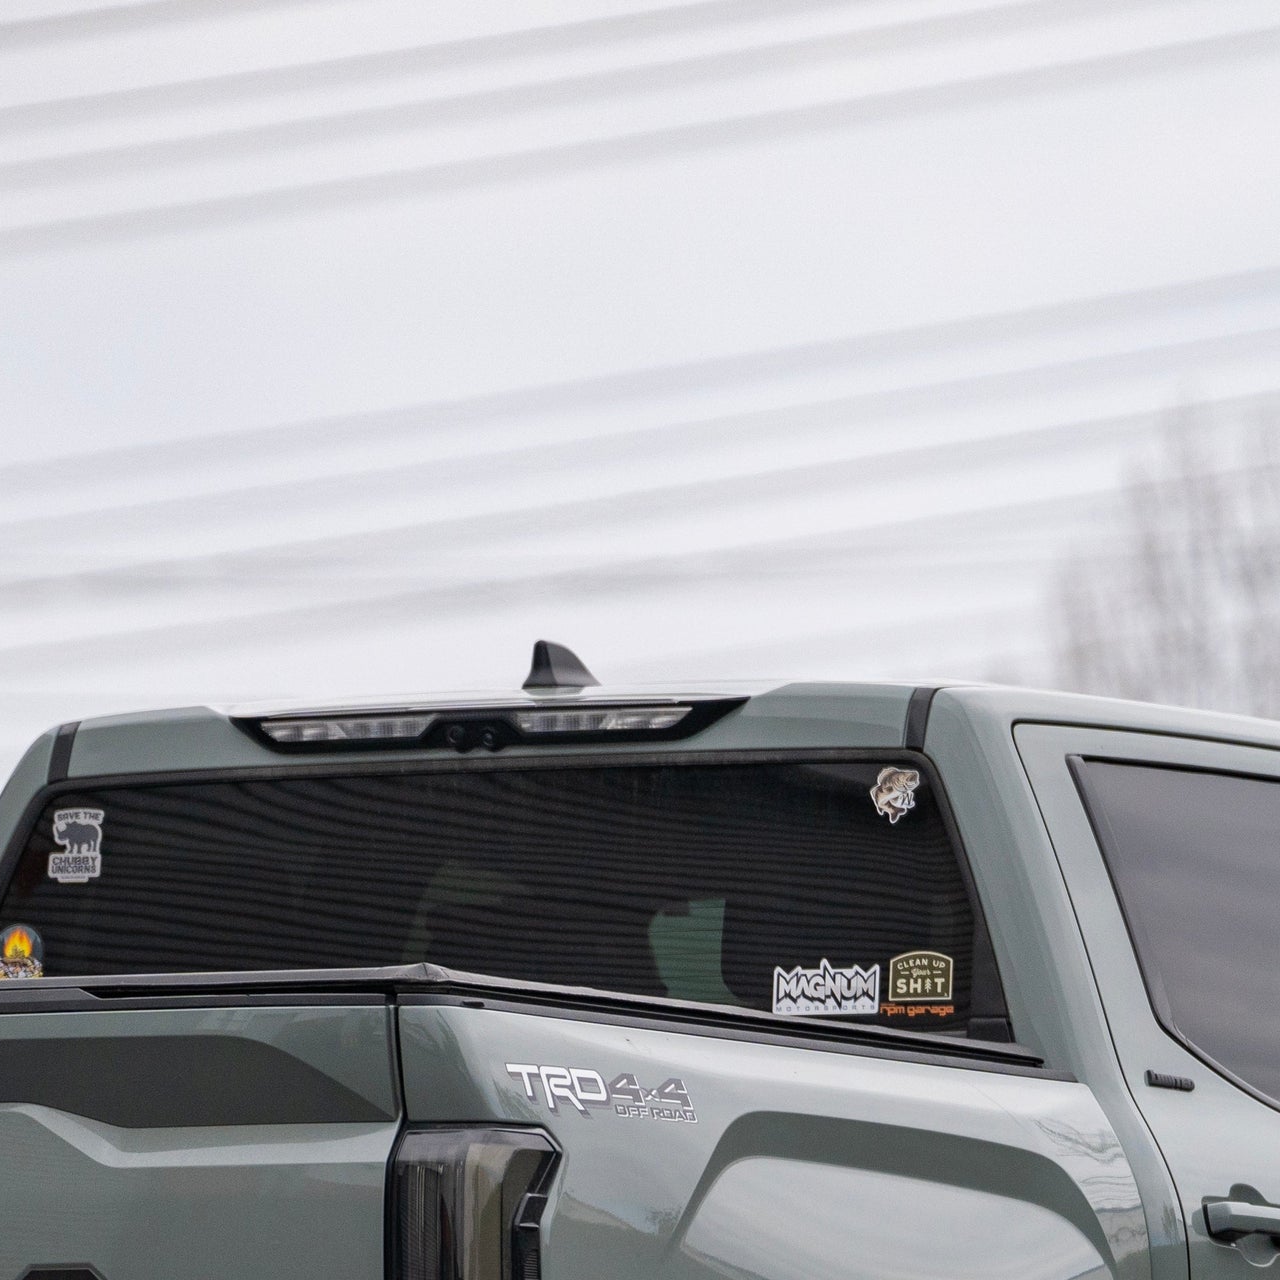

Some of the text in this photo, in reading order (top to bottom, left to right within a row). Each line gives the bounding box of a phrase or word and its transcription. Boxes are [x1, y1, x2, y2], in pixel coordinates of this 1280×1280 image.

[58, 811, 101, 821] SAVE THE
[52, 856, 97, 866] CHUBBY
[51, 865, 96, 875] UNICORNS
[897, 958, 946, 970] CLEAN UP
[776, 963, 877, 1010] MAGNUM
[776, 1004, 876, 1012] MOTORSPORTS
[880, 1005, 954, 1017] rpm garage
[505, 1063, 609, 1113] TRD
[615, 1104, 699, 1124] OFF ROAD
